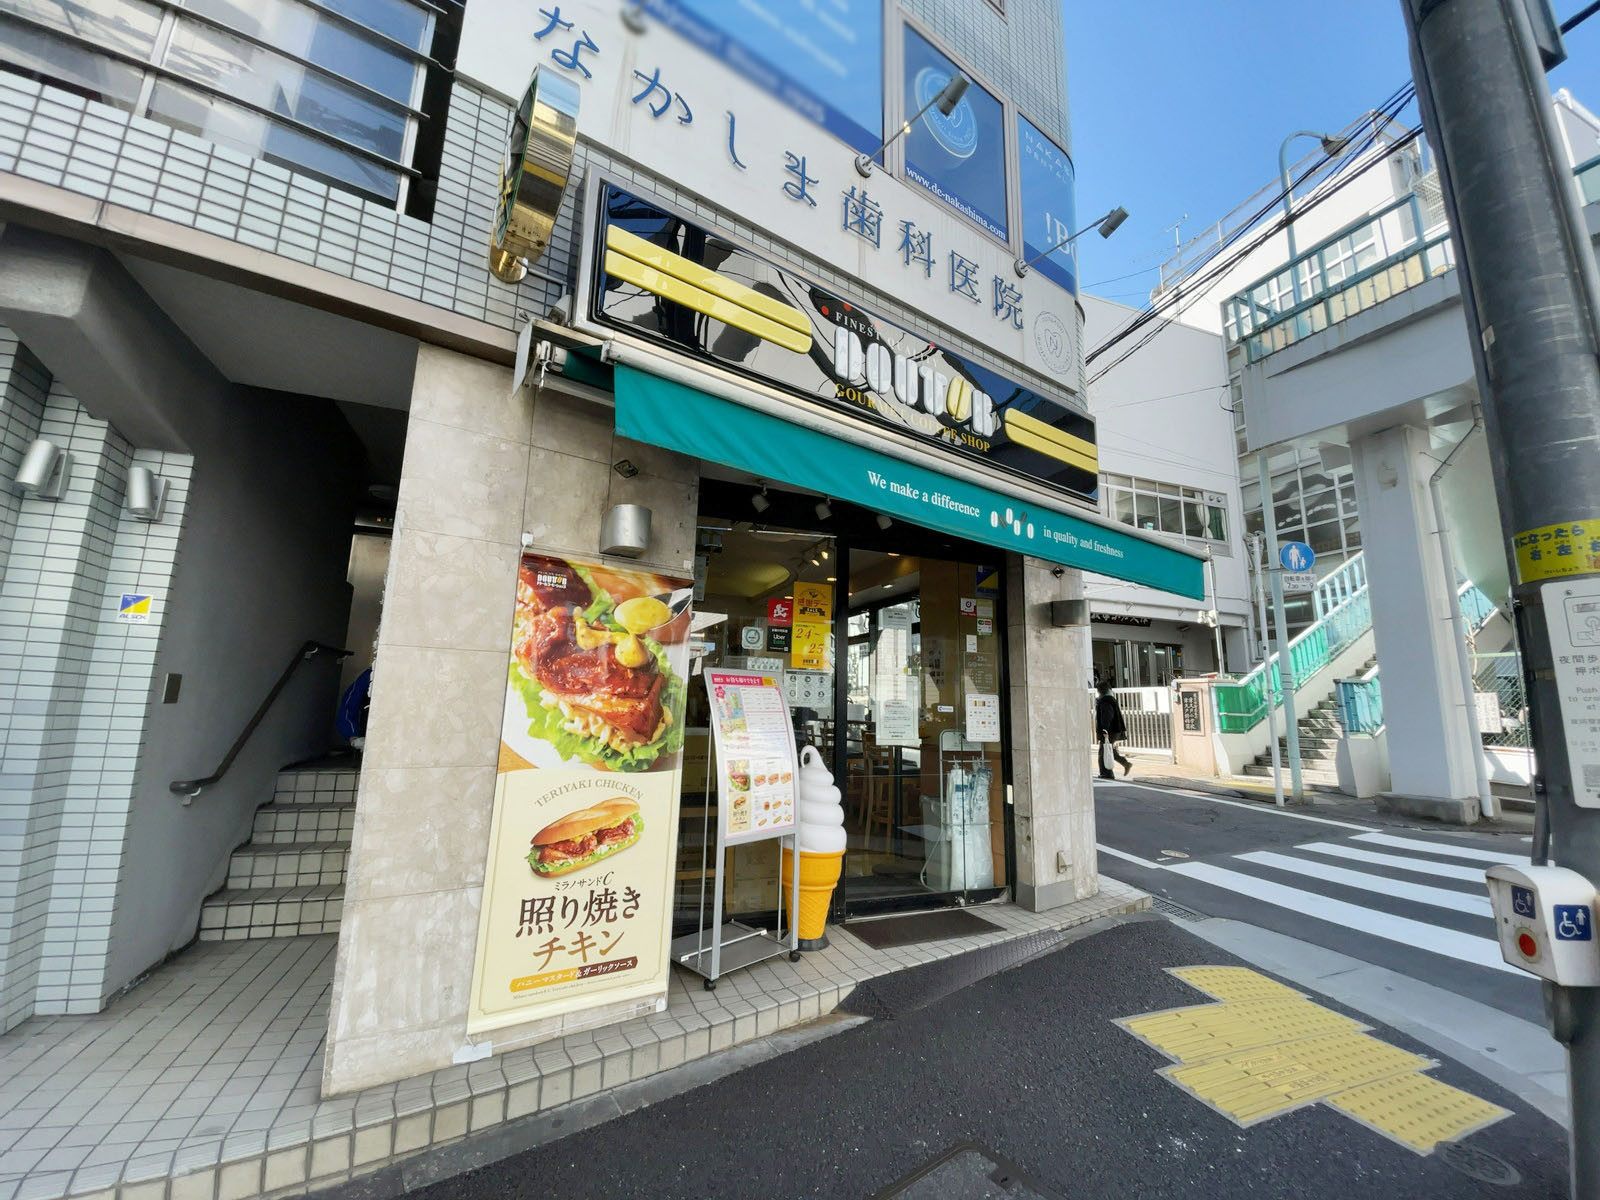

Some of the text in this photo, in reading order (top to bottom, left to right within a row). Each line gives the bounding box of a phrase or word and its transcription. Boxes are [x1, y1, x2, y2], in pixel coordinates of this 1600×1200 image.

[534, 6, 1025, 330] なかしま歯科医院
[906, 166, 1006, 241] www.dc-nakashima.com
[835, 311, 882, 341] FINEST
[835, 326, 994, 438] DOUTOR
[910, 413, 957, 440] COFFEE
[960, 432, 991, 452] SHOP
[867, 470, 980, 518] We make a difference
[1043, 524, 1124, 559] in quality and freshness
[772, 633, 786, 641] Uber
[534, 779, 644, 807] TERIYAKI CHICKEN
[515, 886, 641, 938] 照り焼き
[533, 930, 624, 972] チキン
